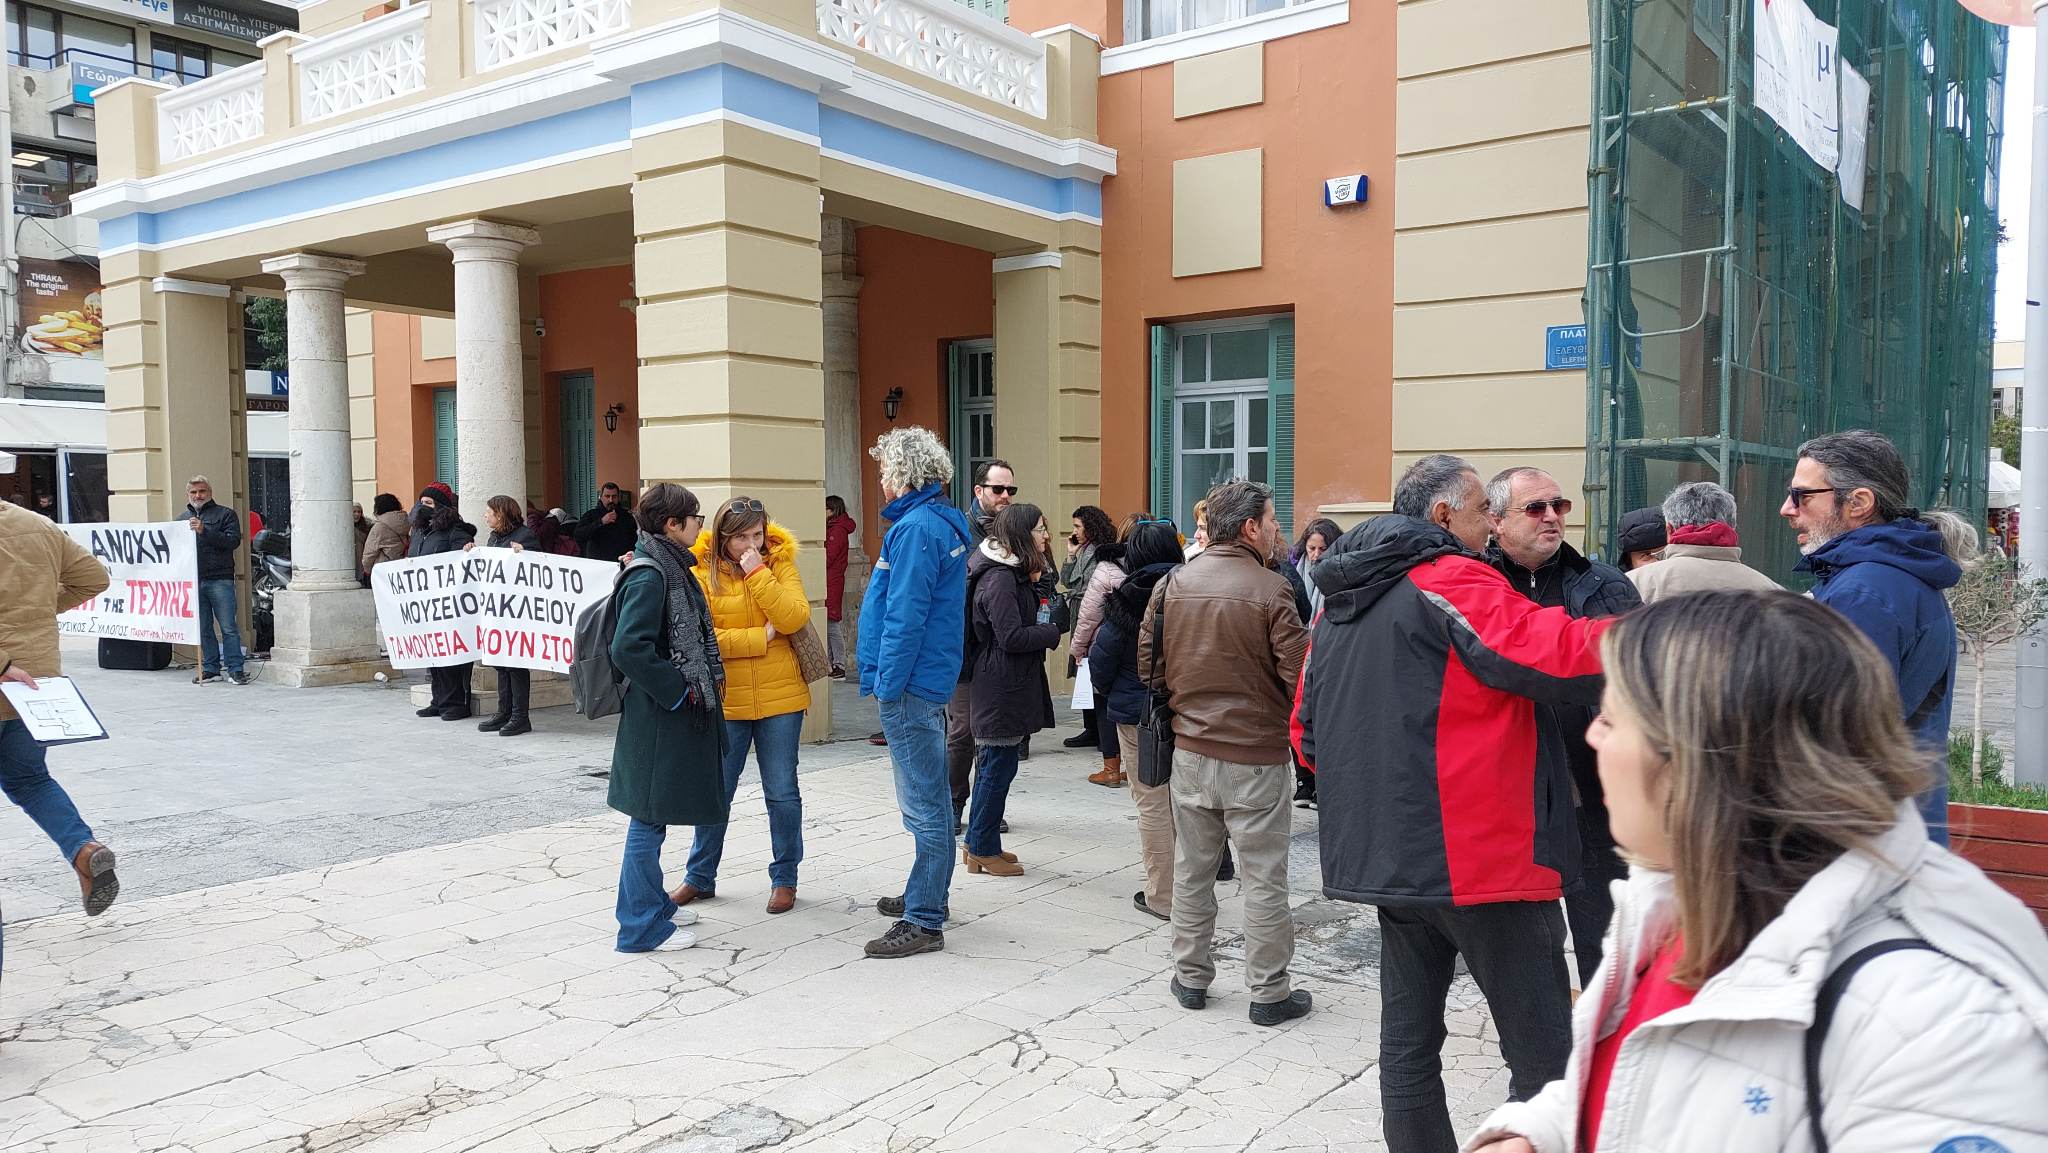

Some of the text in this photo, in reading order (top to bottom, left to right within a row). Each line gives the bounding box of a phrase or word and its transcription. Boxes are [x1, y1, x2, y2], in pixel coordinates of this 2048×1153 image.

[198, 5, 238, 23] ΜΥΩΠΙΑ
[249, 18, 299, 33] ΥΠΕΡΜ
[25, 279, 68, 291] The original
[30, 273, 63, 283] THRAKA
[36, 288, 54, 297] taste
[91, 529, 170, 564] ΑΝΟΧΗ
[387, 567, 428, 595] ΚΑΤΩ
[434, 564, 456, 589] ΤΑ
[514, 561, 553, 590] ΑΠΟ
[559, 567, 584, 595] ΤΟ
[104, 598, 124, 613] ΤΗΣ
[126, 580, 194, 618] ΤΕΧΝΗΣ
[388, 636, 403, 660] ΤΑ
[404, 629, 469, 660] ΜΟΥΣΕΙΑ
[542, 633, 574, 664] ΣΤΟ
